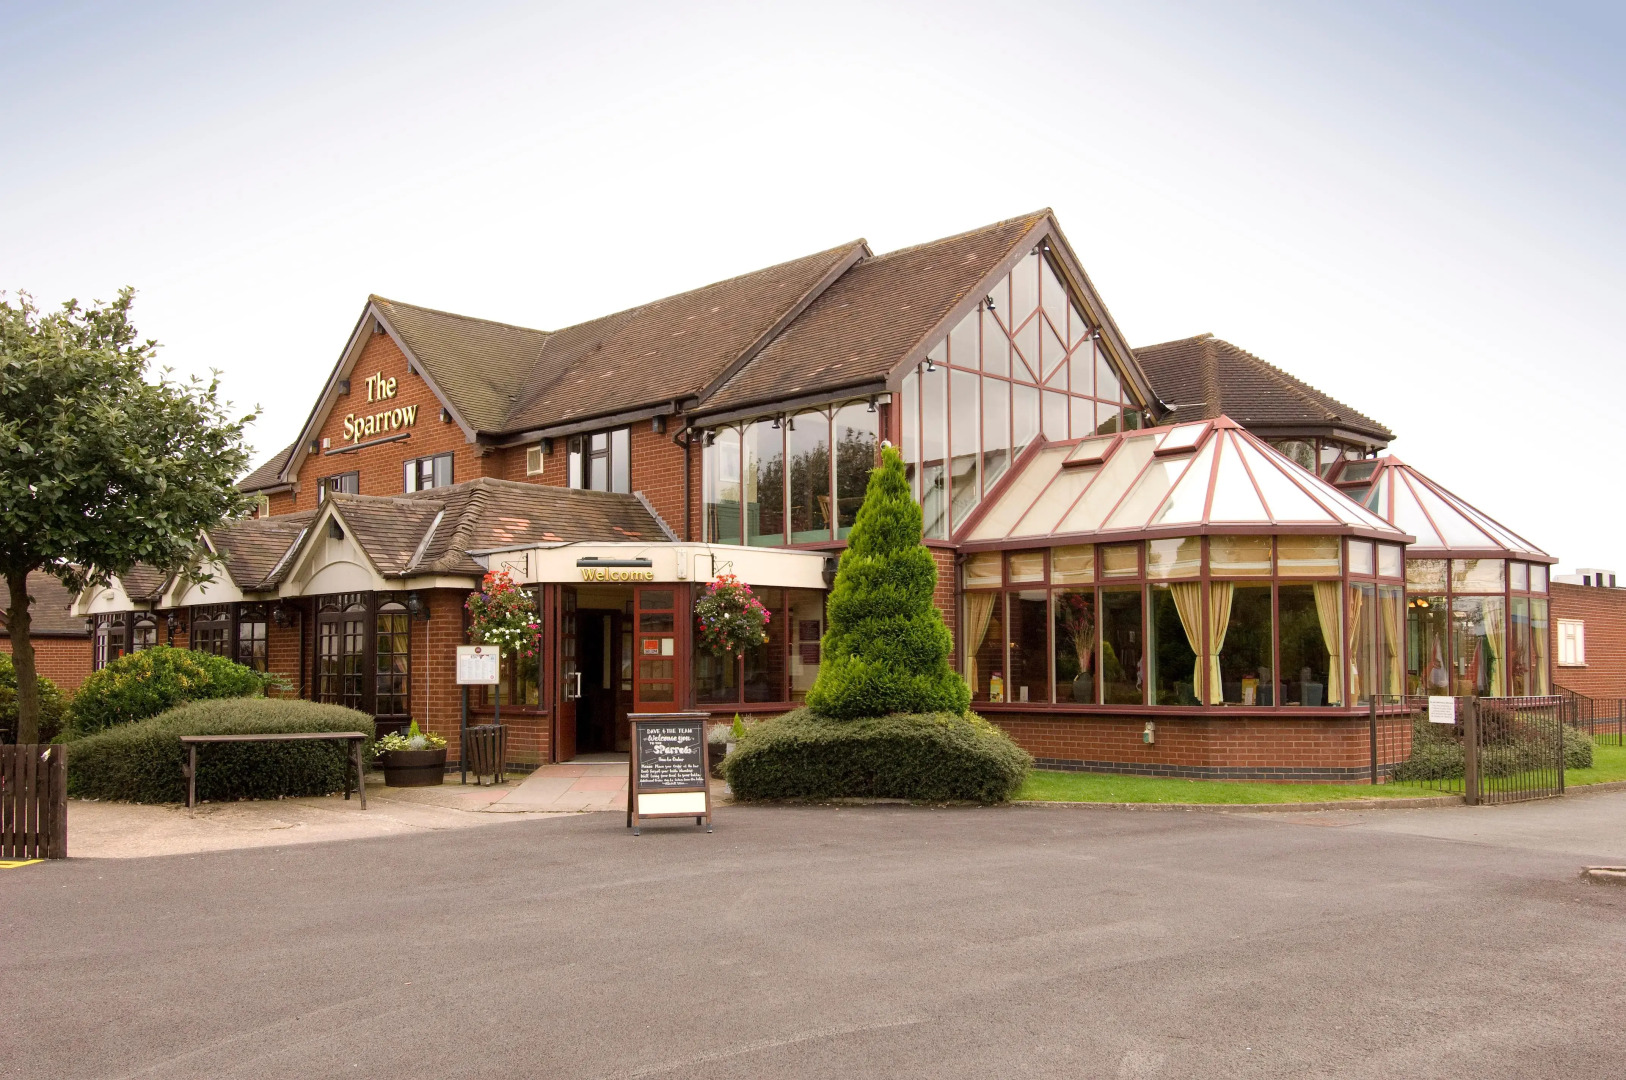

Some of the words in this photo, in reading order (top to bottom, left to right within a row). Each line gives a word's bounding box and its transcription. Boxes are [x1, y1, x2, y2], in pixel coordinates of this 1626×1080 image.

[365, 371, 397, 403] The
[343, 404, 418, 444] Sparrow
[581, 567, 653, 581] Welcome
[648, 734, 677, 742] Welcome
[677, 735, 692, 744] you
